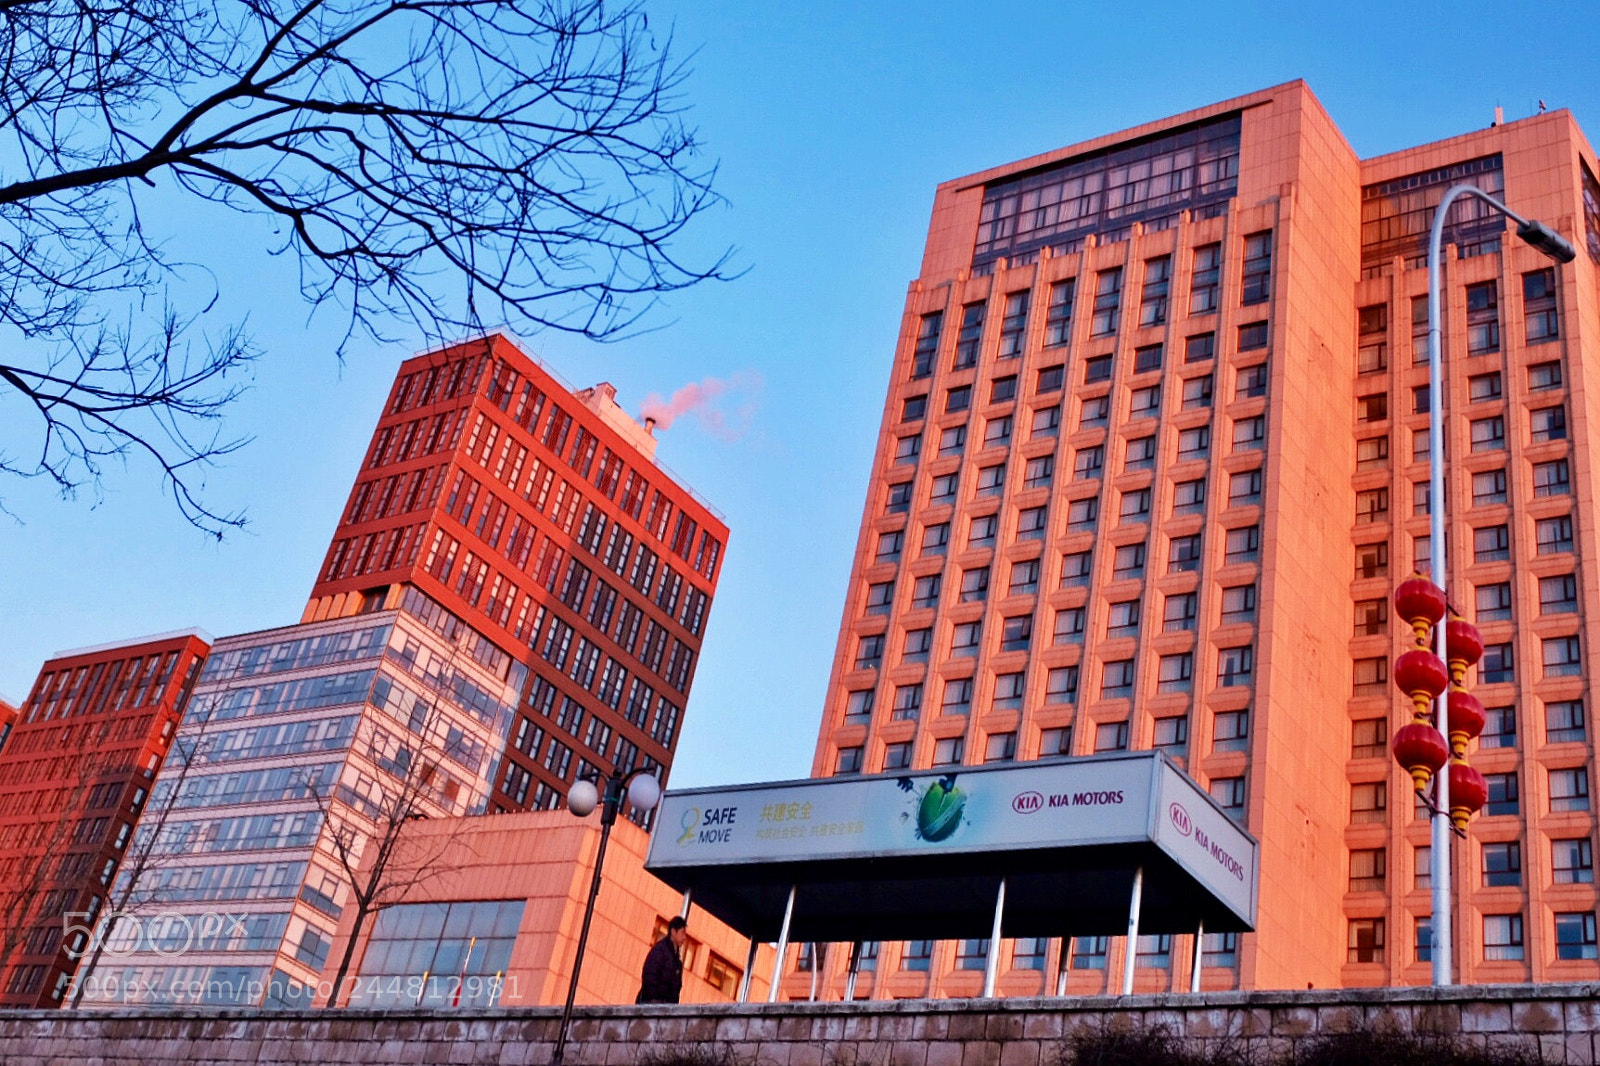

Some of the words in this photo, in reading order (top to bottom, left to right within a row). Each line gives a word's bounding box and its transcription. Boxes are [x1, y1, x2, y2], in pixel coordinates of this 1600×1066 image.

[1048, 794, 1069, 807] KIA
[1072, 790, 1124, 805] MOTORS
[702, 807, 738, 826] SAFE
[760, 801, 813, 822] 共建安全
[698, 828, 732, 844] MOVE
[1195, 826, 1209, 852] KIA
[1210, 841, 1244, 882] MOTORS
